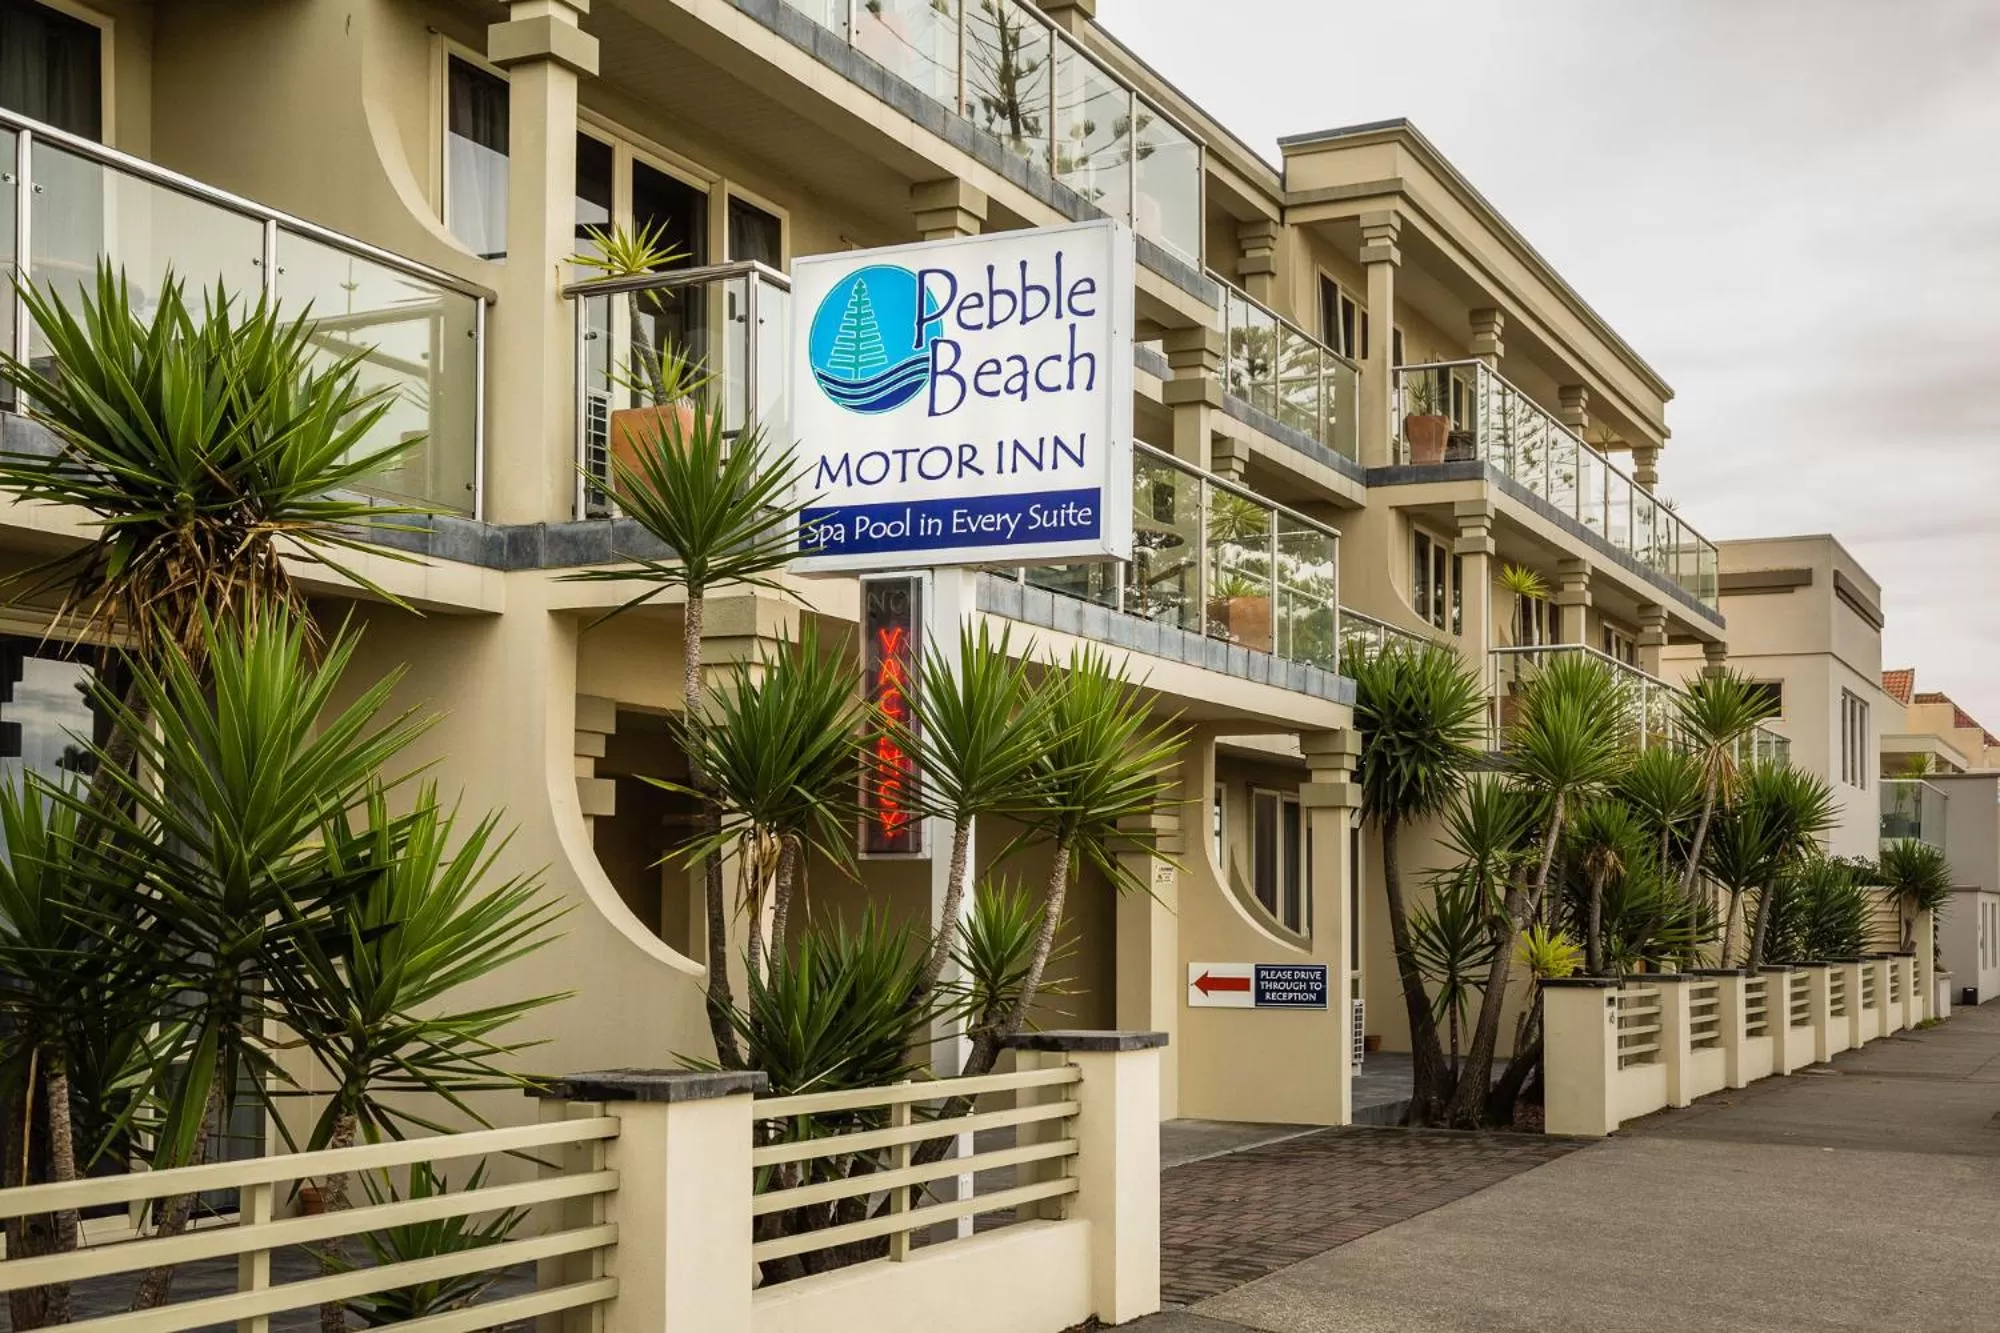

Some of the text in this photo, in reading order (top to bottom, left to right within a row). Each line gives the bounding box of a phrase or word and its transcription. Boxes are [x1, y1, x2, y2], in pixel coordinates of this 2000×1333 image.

[914, 250, 1097, 349] Pebble
[927, 323, 1096, 417] Beach
[814, 432, 1086, 490] MOTOR INN
[854, 507, 911, 541] Pool
[919, 512, 943, 537] in
[951, 508, 1022, 540] Every
[1027, 501, 1093, 530] Suite
[879, 627, 902, 838] VACNCY
[1260, 969, 1322, 980] PLEASE DRIVE
[1260, 980, 1323, 991] THROUGH TO
[1265, 991, 1317, 1001] RECEPTION
